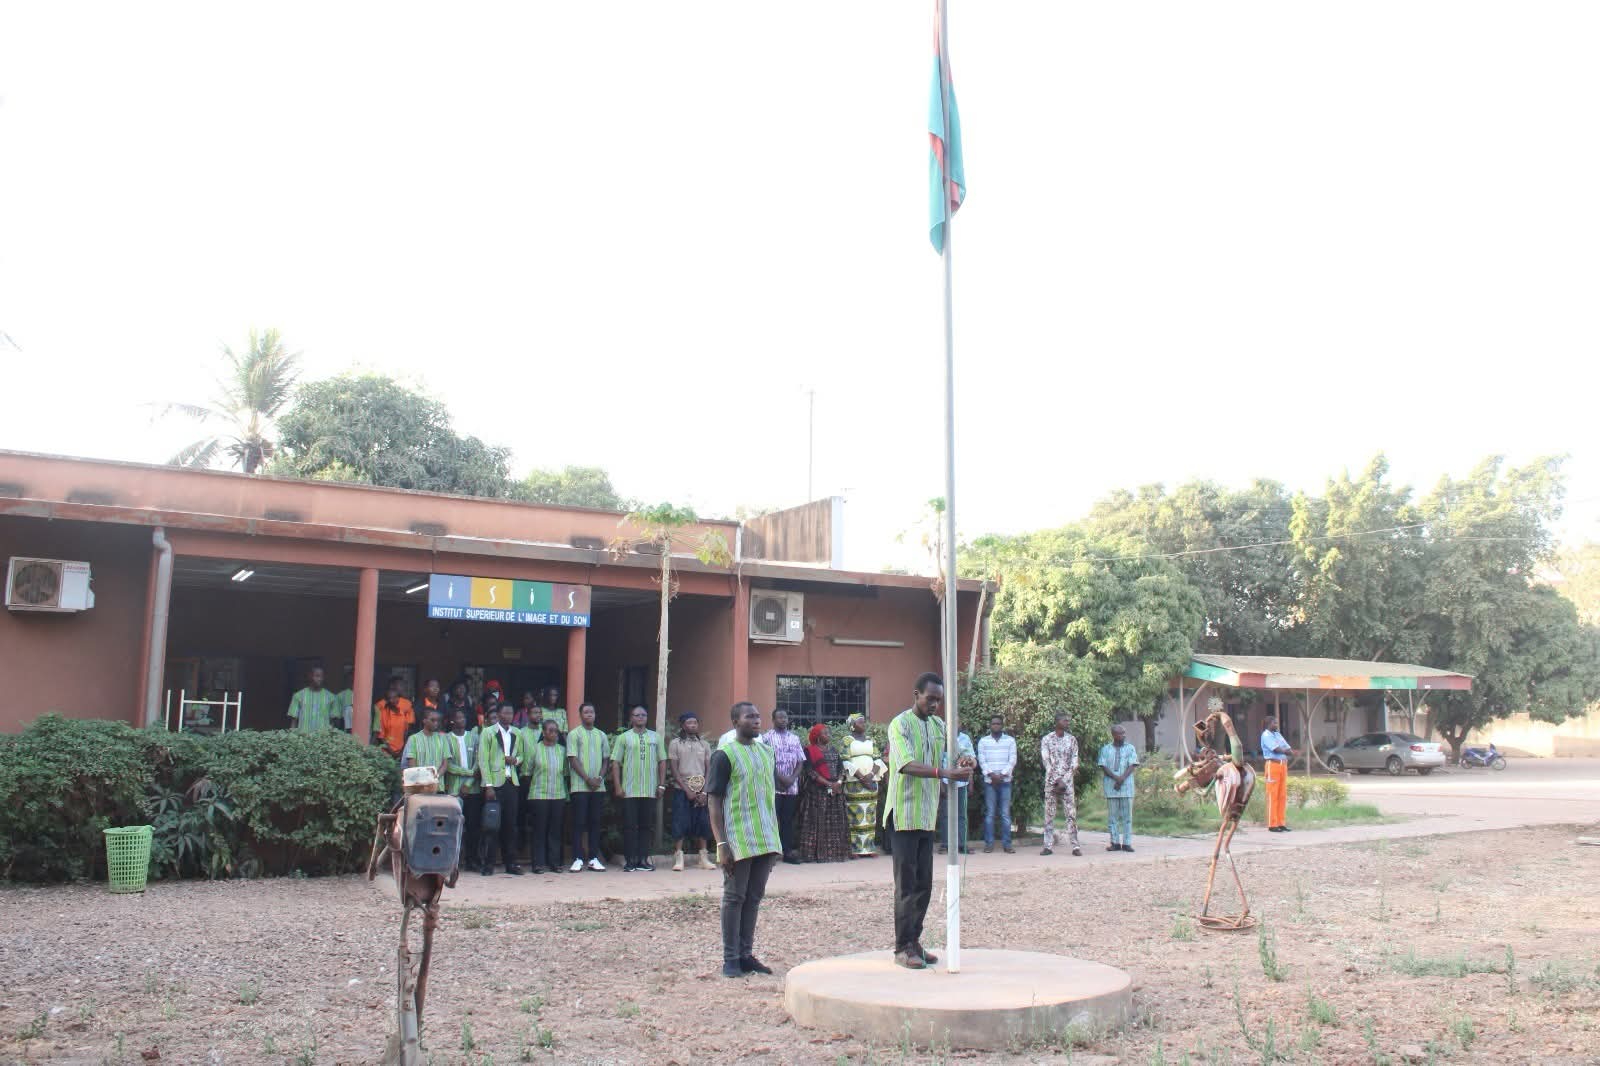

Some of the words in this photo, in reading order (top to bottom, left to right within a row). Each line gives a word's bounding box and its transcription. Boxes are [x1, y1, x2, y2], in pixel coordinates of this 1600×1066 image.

[432, 606, 463, 617] INSTITUT
[466, 609, 504, 620] SUPERIEUR
[505, 611, 515, 621] DE
[518, 612, 546, 623] L'IMAGE
[549, 614, 558, 624] ET
[561, 615, 570, 625] DU
[573, 615, 587, 625] SON
